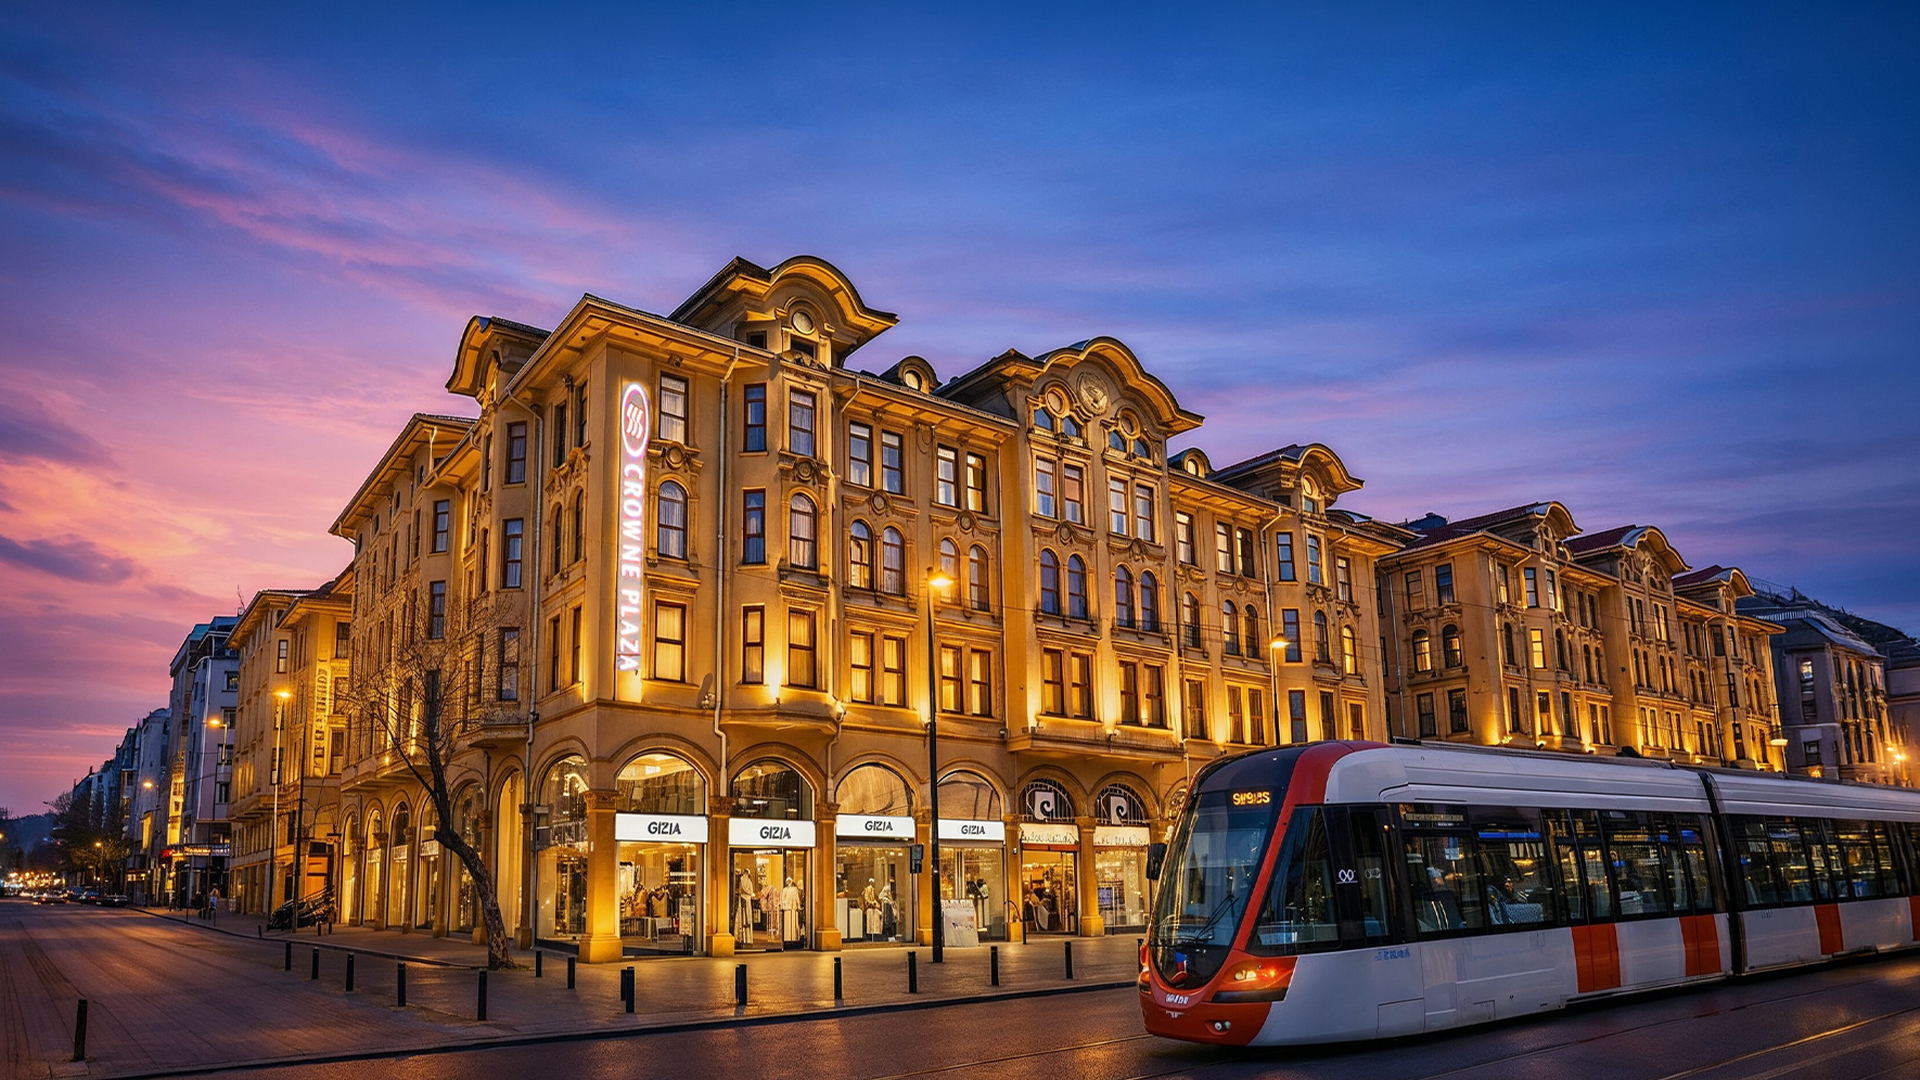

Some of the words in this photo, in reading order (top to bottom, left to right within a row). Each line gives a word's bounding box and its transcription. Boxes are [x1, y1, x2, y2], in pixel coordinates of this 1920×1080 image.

[623, 463, 642, 580] CROWNE
[619, 588, 640, 670] PLAZA
[647, 821, 682, 835] GIZIA
[759, 826, 791, 840] GIZIA
[864, 820, 893, 832] GIZIA
[961, 824, 986, 836] GIZIA
